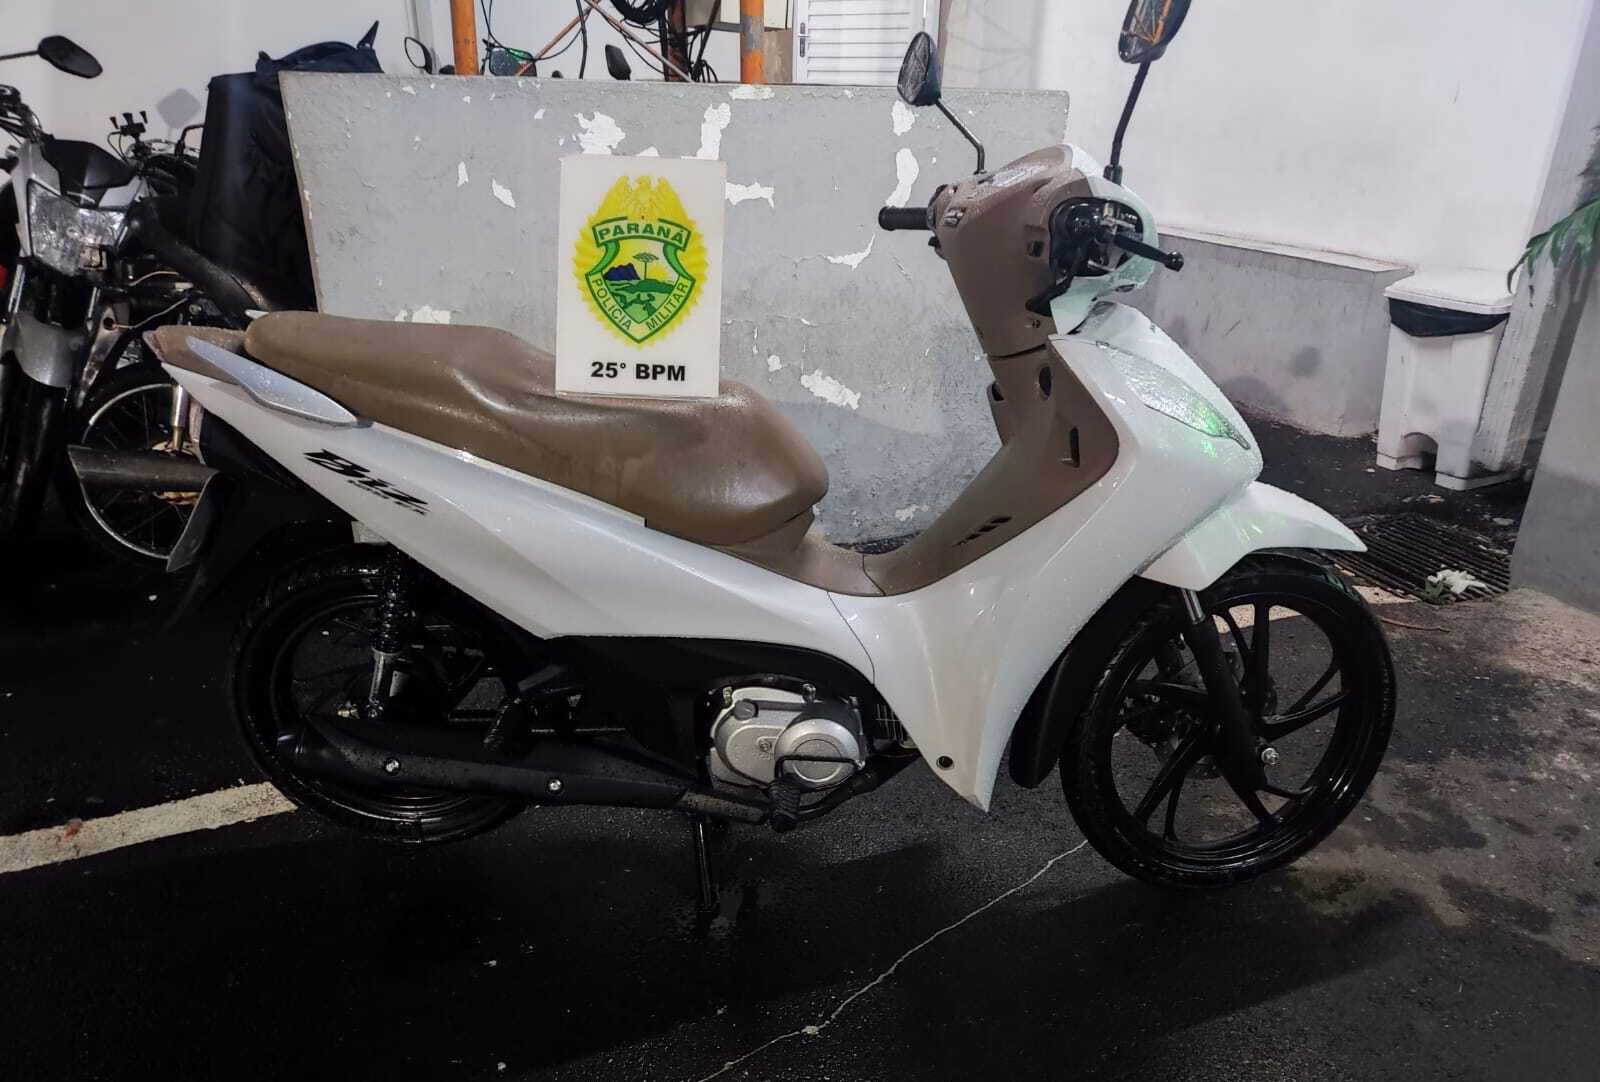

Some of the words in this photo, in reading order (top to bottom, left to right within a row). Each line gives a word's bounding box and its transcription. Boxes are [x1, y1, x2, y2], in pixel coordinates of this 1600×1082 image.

[598, 222, 684, 245] PARANÁ
[592, 278, 632, 331] POLICIA
[645, 282, 689, 331] MILITAR
[635, 363, 686, 382] BPM
